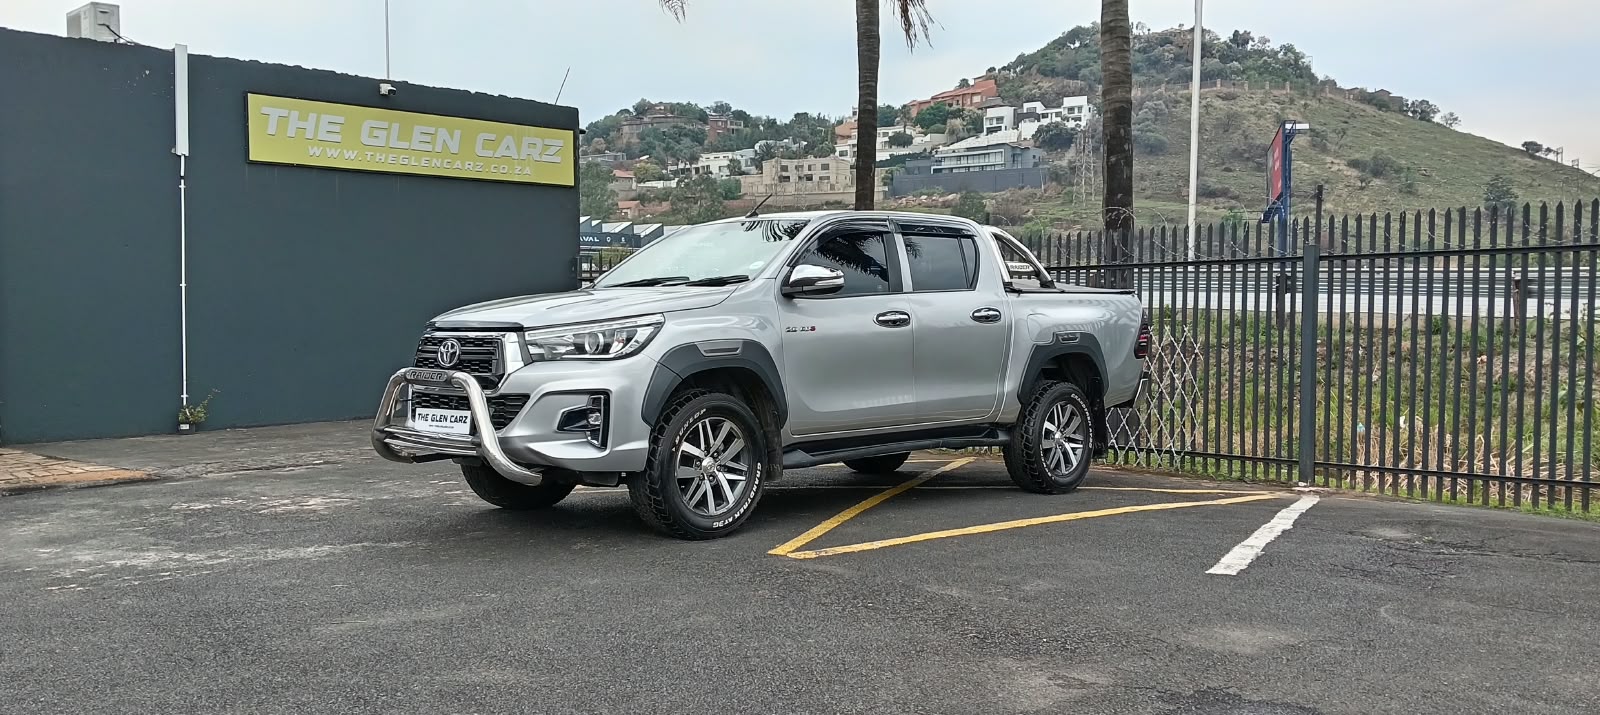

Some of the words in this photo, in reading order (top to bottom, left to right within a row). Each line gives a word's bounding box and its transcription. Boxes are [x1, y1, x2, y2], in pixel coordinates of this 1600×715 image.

[260, 106, 345, 143] THE
[360, 119, 461, 154] GLEN
[475, 132, 564, 163] CARZ
[418, 413, 429, 421] THE
[431, 413, 448, 422] GLEN
[450, 415, 468, 423] CARZ
